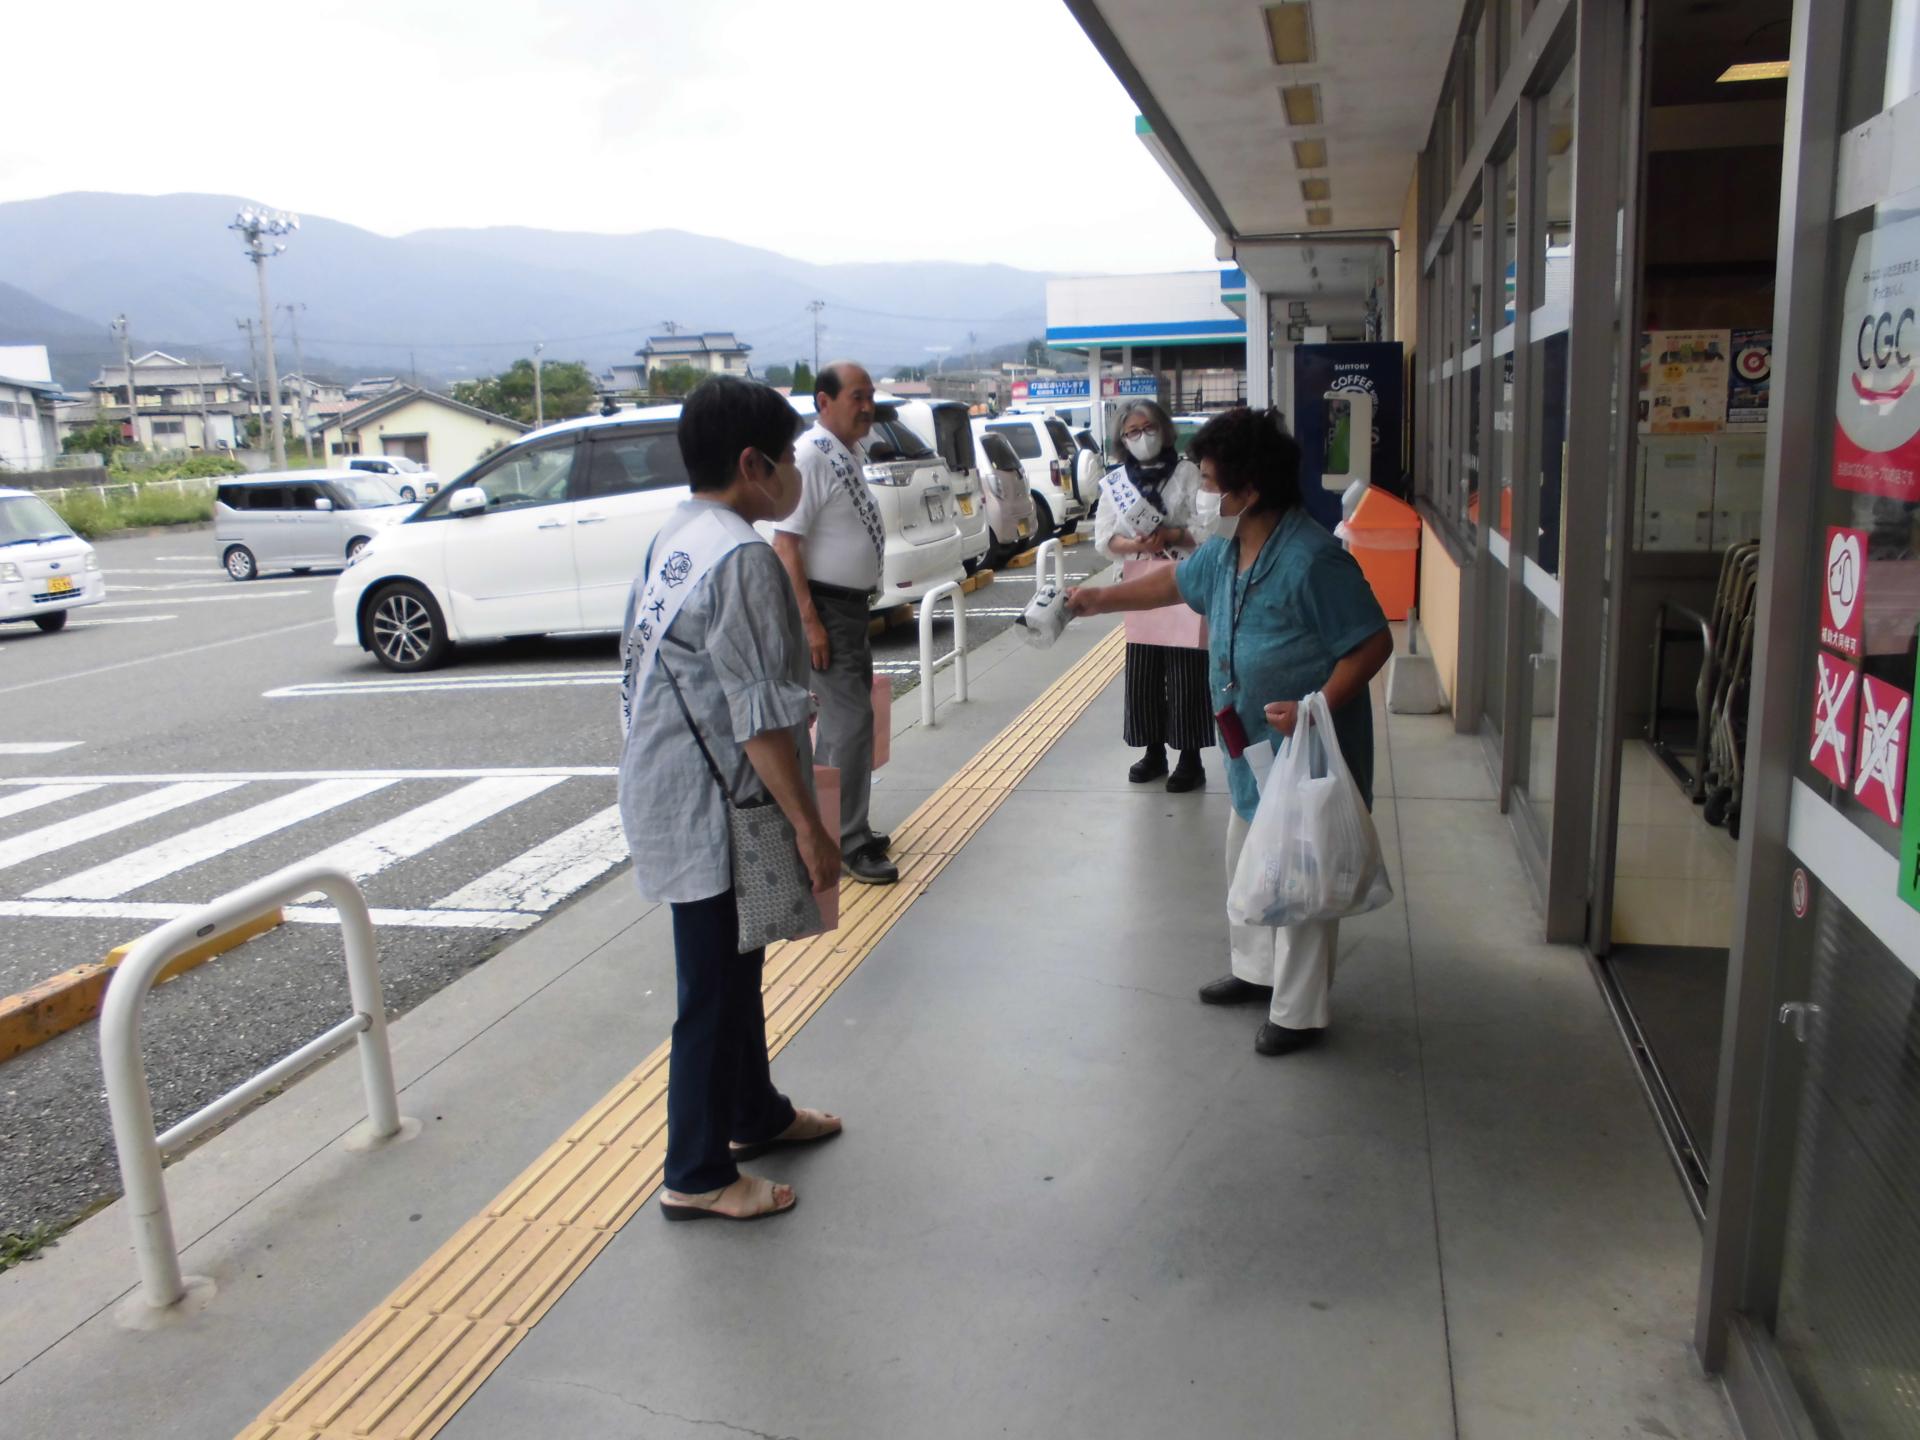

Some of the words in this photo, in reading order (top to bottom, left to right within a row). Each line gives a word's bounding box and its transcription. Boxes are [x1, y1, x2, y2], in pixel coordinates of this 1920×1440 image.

[1858, 307, 1915, 371] CGC
[1334, 363, 1370, 371] SUNTORY
[1331, 375, 1374, 390] COFFEE
